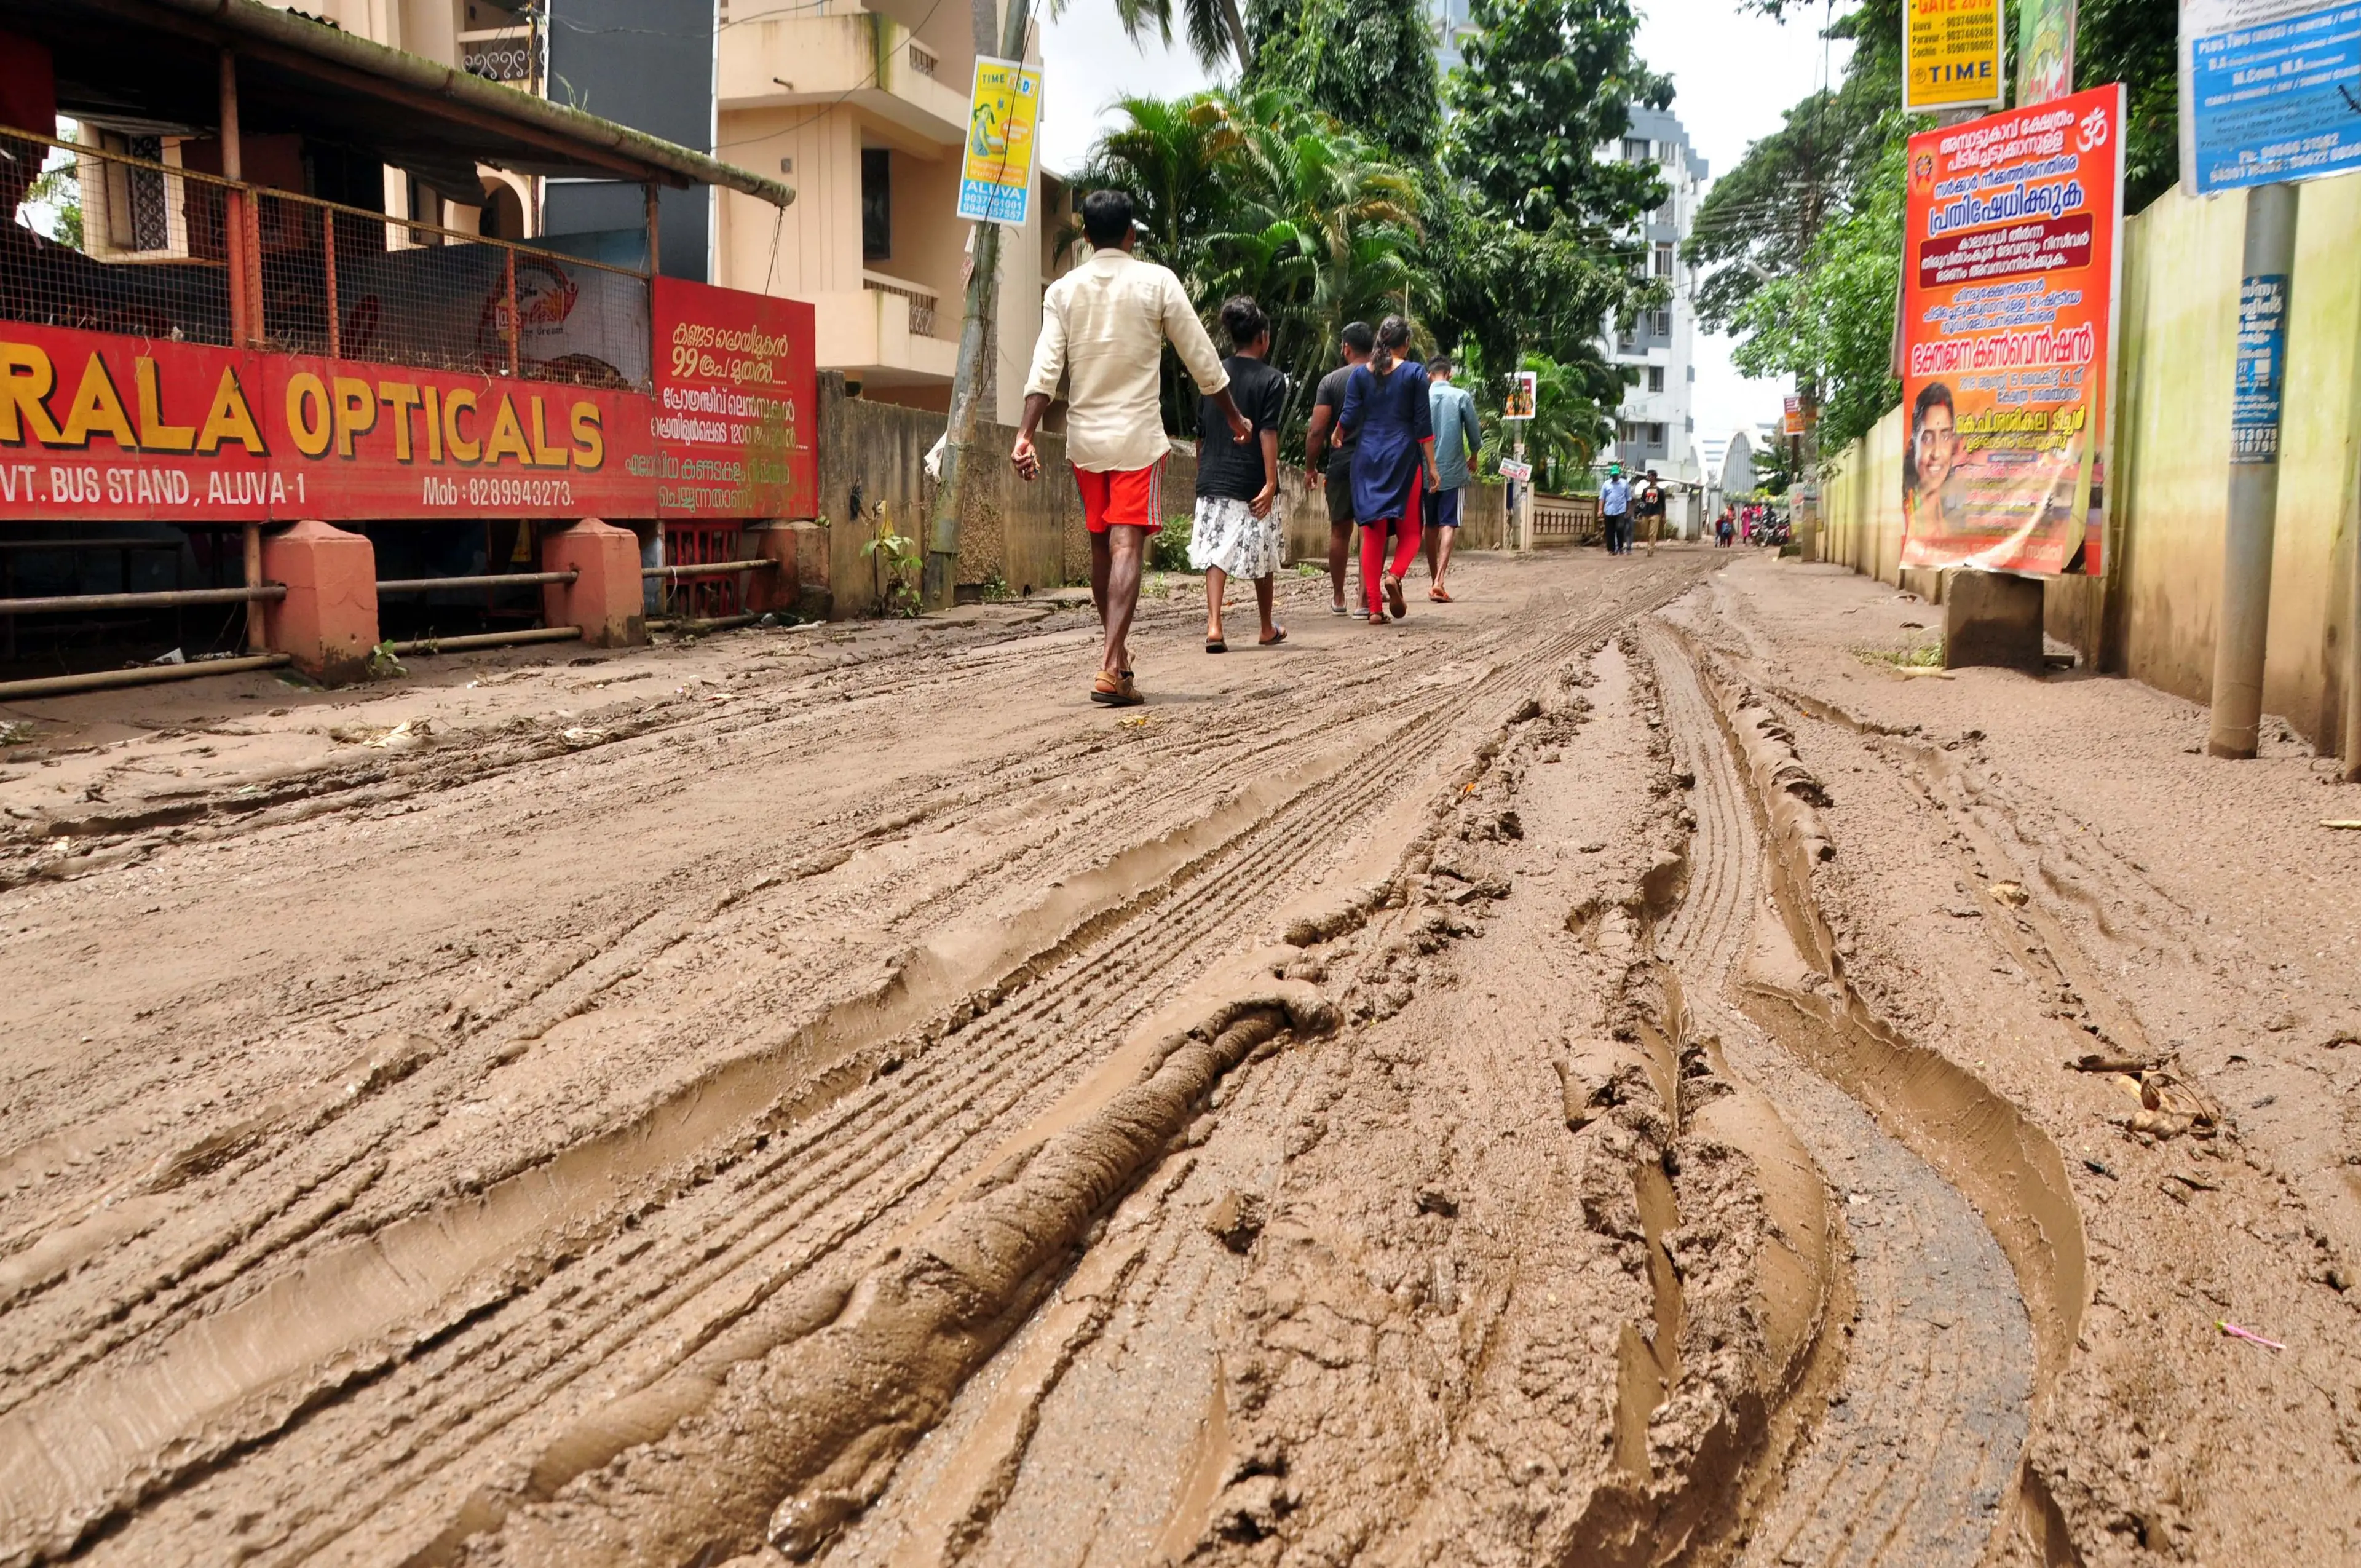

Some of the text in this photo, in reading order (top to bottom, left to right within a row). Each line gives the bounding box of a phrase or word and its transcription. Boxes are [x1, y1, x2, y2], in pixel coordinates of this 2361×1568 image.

[982, 73, 1005, 84] TIME
[1928, 61, 1993, 84] TIME
[966, 180, 1021, 200] ALUVA
[1929, 181, 2083, 236] പ്രതിഷേധിക്കുക
[673, 323, 714, 348] കണ്ണട
[671, 346, 698, 378] 99
[699, 354, 730, 378] രൂപ
[2062, 369, 2070, 383] 4
[286, 372, 604, 471] OPTICALS
[730, 422, 751, 445] 1200
[51, 466, 101, 503] BUS
[106, 468, 200, 507] STAND,
